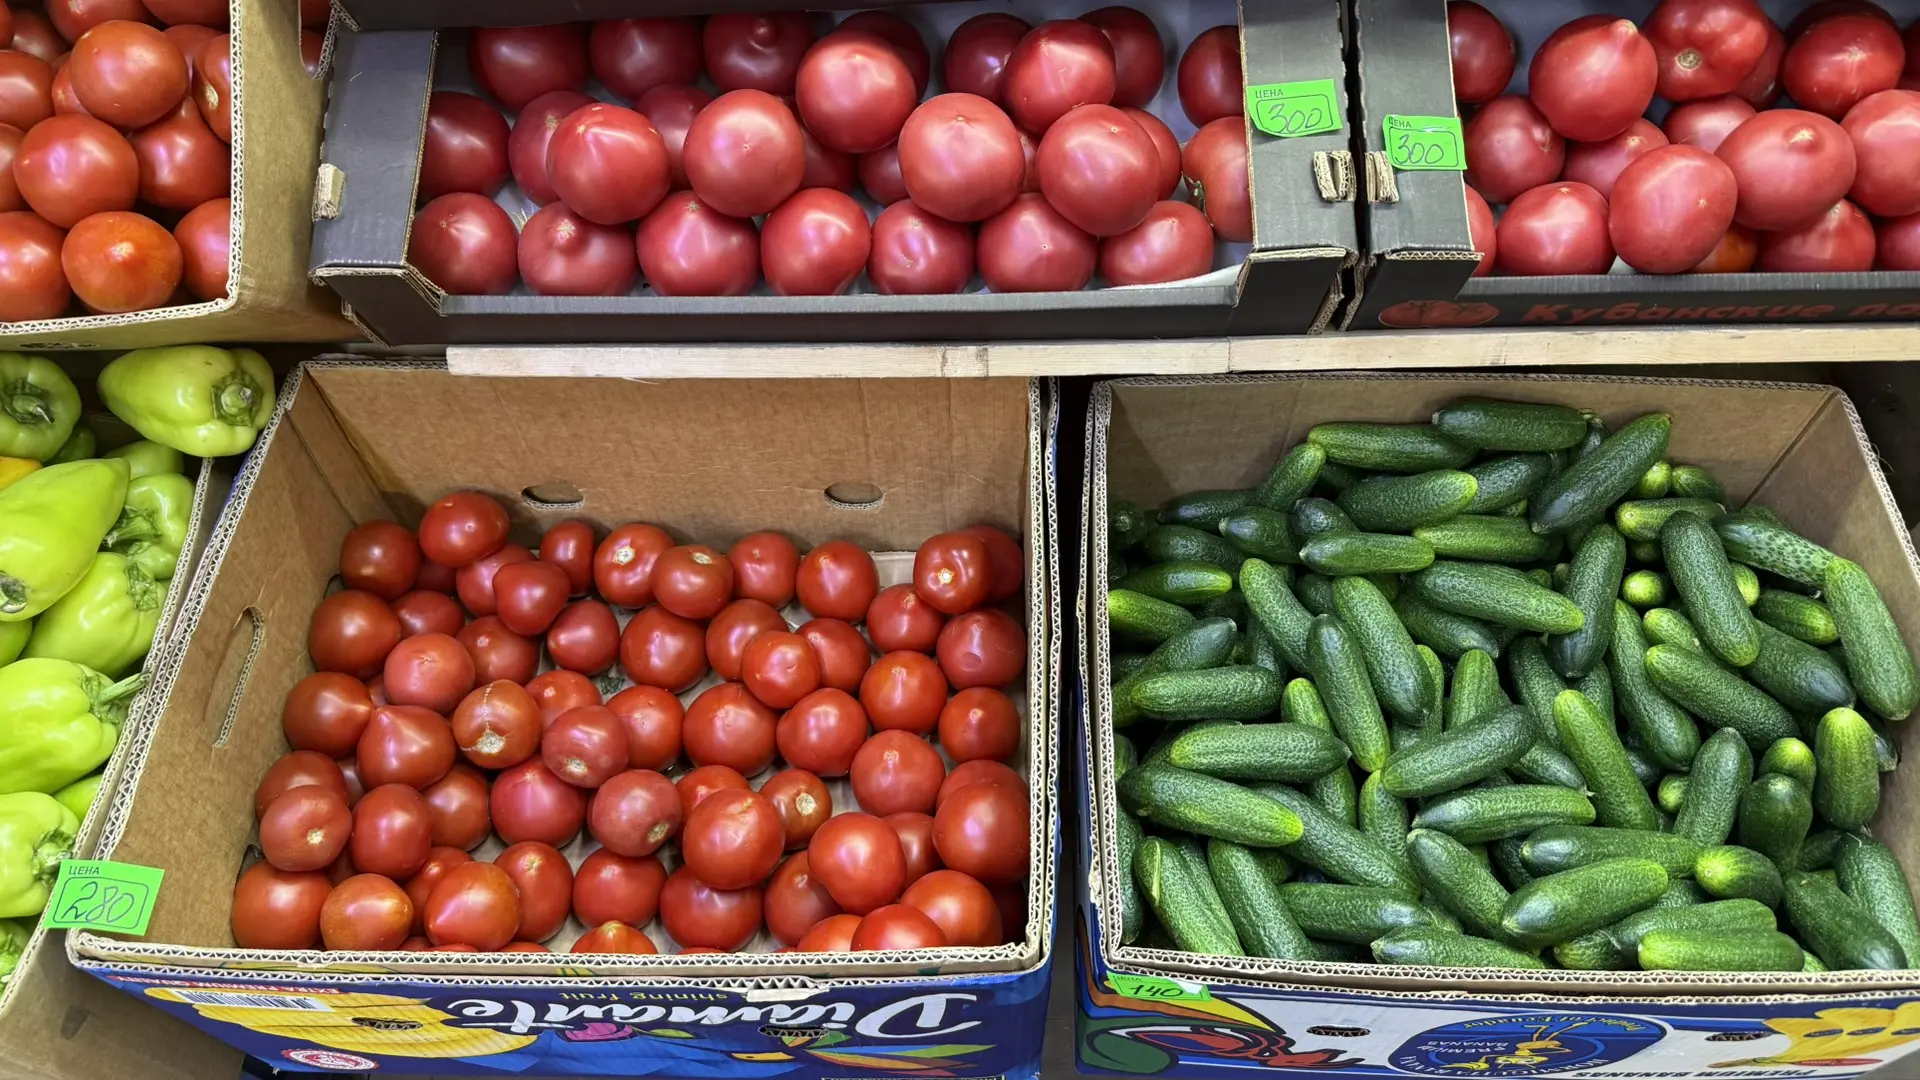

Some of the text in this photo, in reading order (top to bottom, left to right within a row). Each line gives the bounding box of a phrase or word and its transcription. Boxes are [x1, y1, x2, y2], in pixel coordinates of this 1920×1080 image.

[1255, 88, 1284, 99] ЦЕНА
[1268, 103, 1323, 134] 300
[1388, 117, 1412, 128] ЦЕНА
[1397, 134, 1444, 165] 300
[1521, 302, 1835, 323] Кубанские
[68, 866, 100, 876] ЦЕНА
[61, 881, 135, 923] 280
[192, 981, 279, 991] PREMIUM
[280, 985, 339, 994] EXTRA
[1130, 984, 1184, 997] 140
[558, 992, 728, 1001] shining fruit
[447, 992, 982, 1039] Diamante
[1463, 1016, 1553, 1030] Ecuador
[1693, 1069, 1817, 1078] PREMIUM
